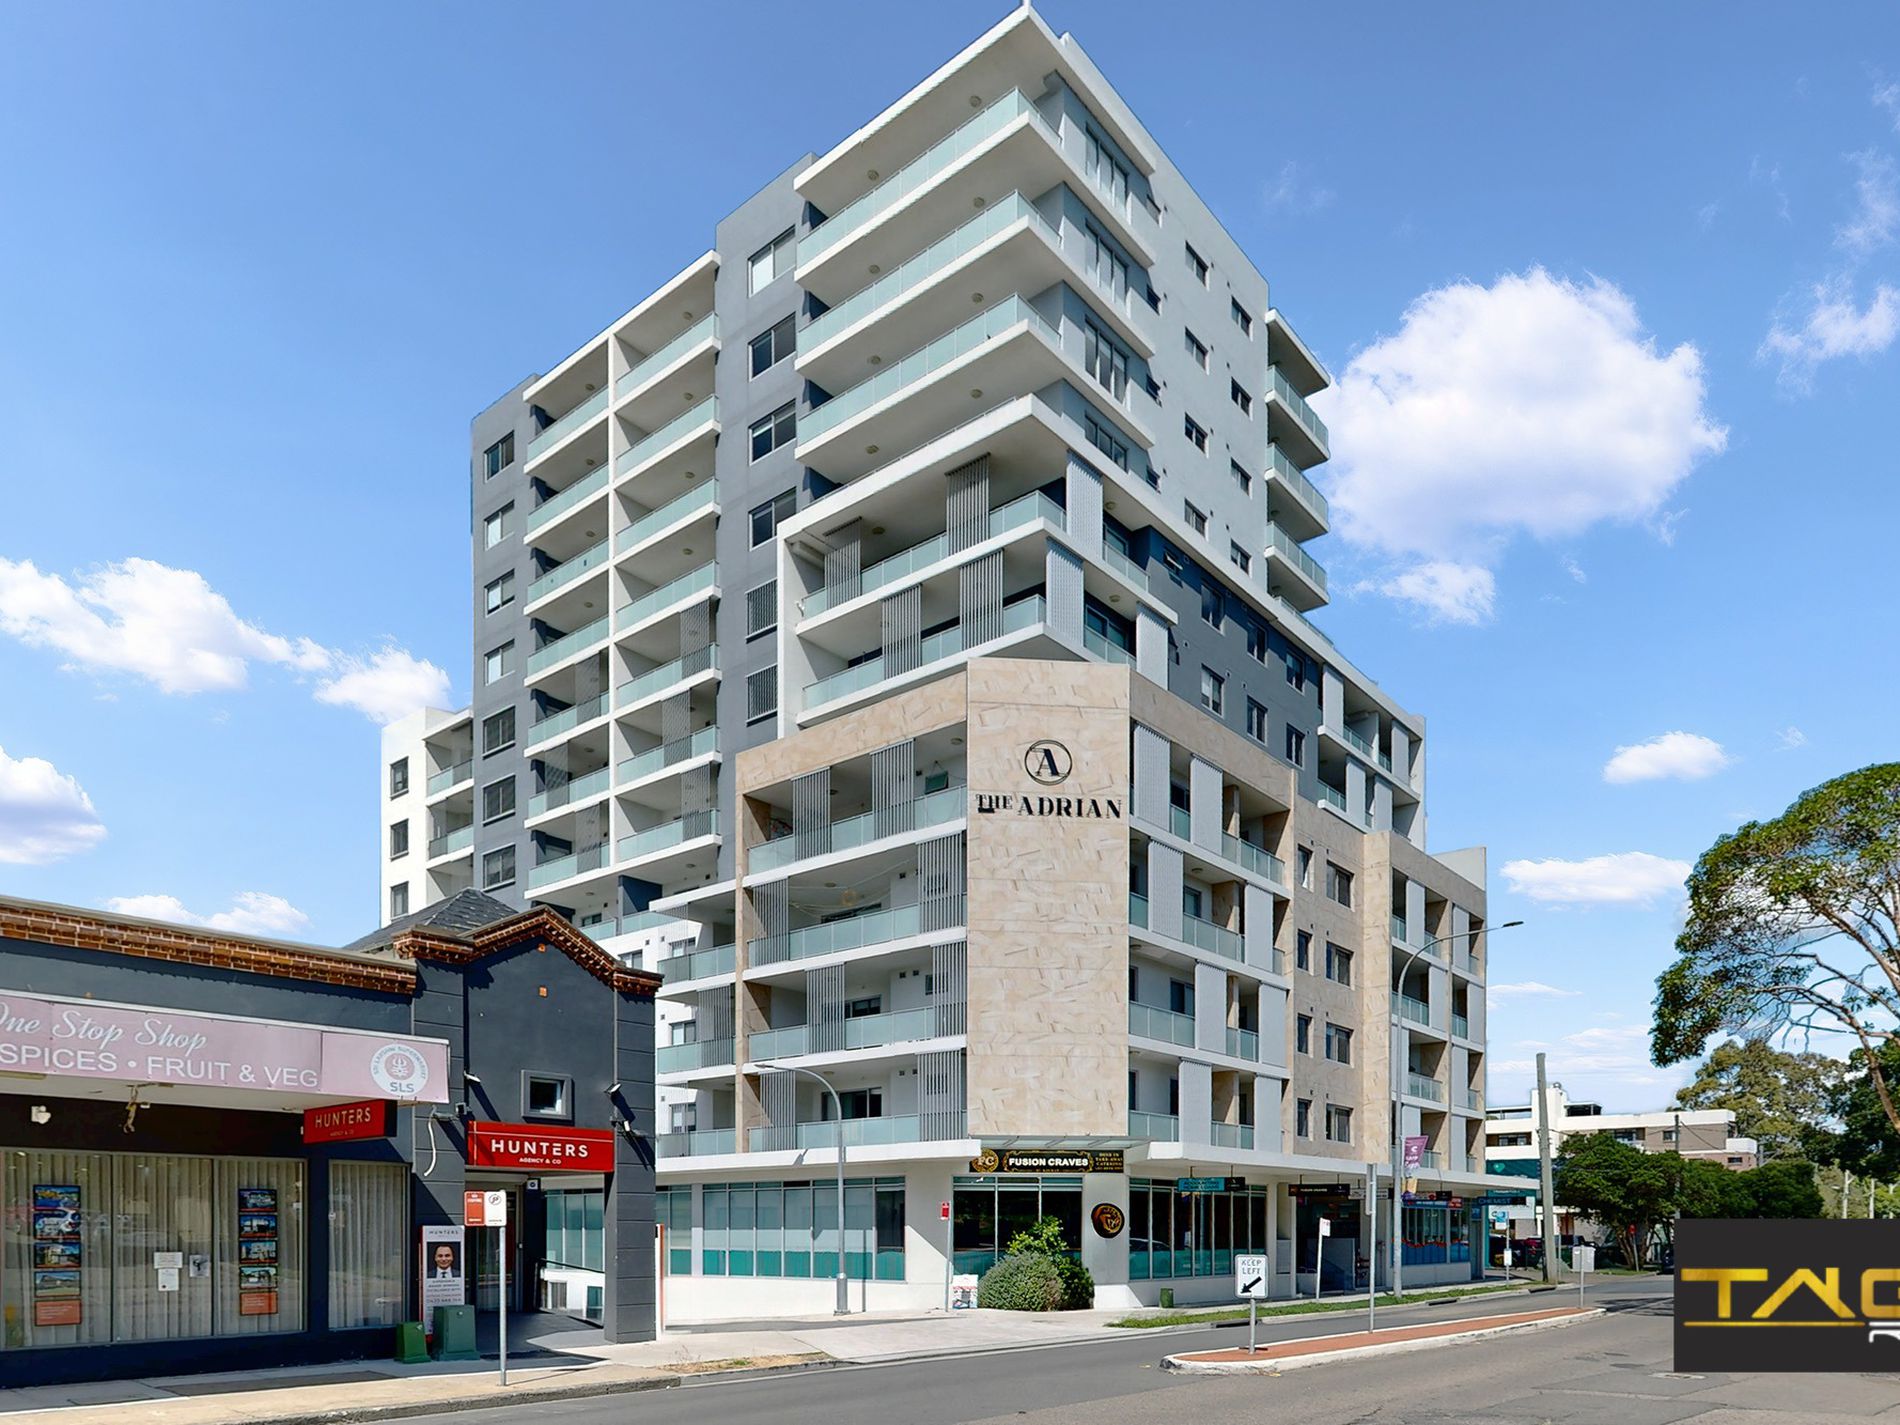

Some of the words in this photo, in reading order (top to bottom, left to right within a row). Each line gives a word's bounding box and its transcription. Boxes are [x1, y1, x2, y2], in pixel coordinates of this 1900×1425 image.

[975, 794, 1013, 811] THE
[1018, 795, 1122, 818] ADRIAN
[52, 1010, 123, 1050] Stop
[135, 1018, 208, 1059] Shop
[0, 1043, 117, 1072] SPICES
[147, 1056, 231, 1082] FRUIT
[239, 1064, 256, 1083] &
[264, 1066, 319, 1088] VEG
[390, 1081, 415, 1093] SLS
[315, 1106, 371, 1128] HUNTERS
[491, 1139, 588, 1158] HUNTERS
[1009, 1157, 1045, 1167] FUSION
[1047, 1157, 1088, 1167] CRAVES
